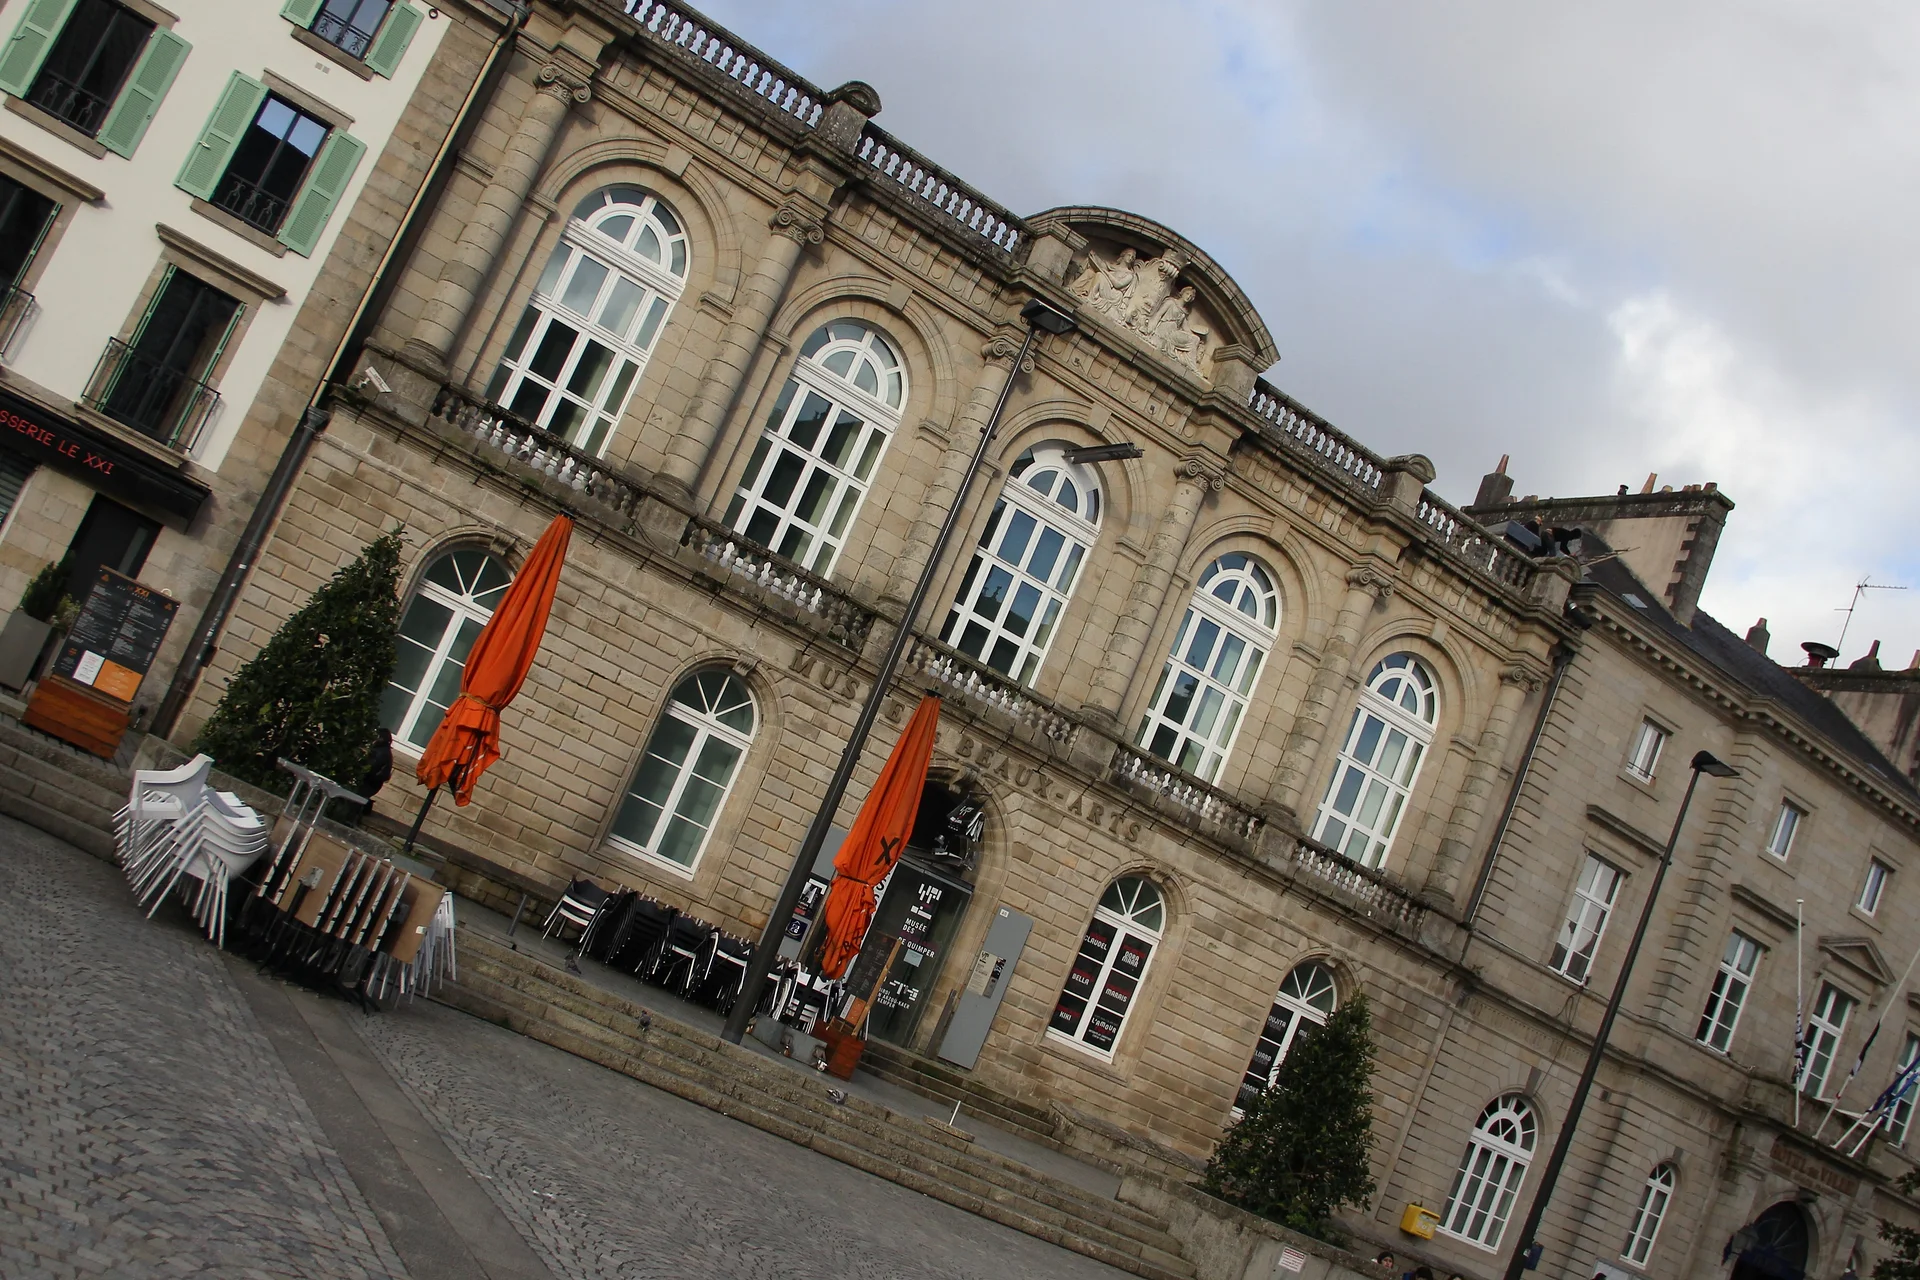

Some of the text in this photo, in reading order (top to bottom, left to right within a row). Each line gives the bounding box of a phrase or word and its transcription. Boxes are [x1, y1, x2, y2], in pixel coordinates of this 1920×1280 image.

[57, 440, 80, 458] LE
[82, 452, 114, 475] XXI
[788, 650, 1142, 843] MUSE BEAUX-ARTS
[902, 924, 916, 935] DES
[905, 917, 928, 933] MUSÉE
[907, 941, 935, 958] QUIMPER
[1084, 934, 1108, 951] CLAUDEL
[1071, 972, 1090, 986] BELLA
[1105, 988, 1128, 1003] MARAIS
[1059, 1011, 1072, 1021] KIKI
[1268, 1015, 1287, 1028] OUJITA
[1091, 1017, 1117, 1034] L'AMOUR
[1255, 1049, 1272, 1062] LUARD
